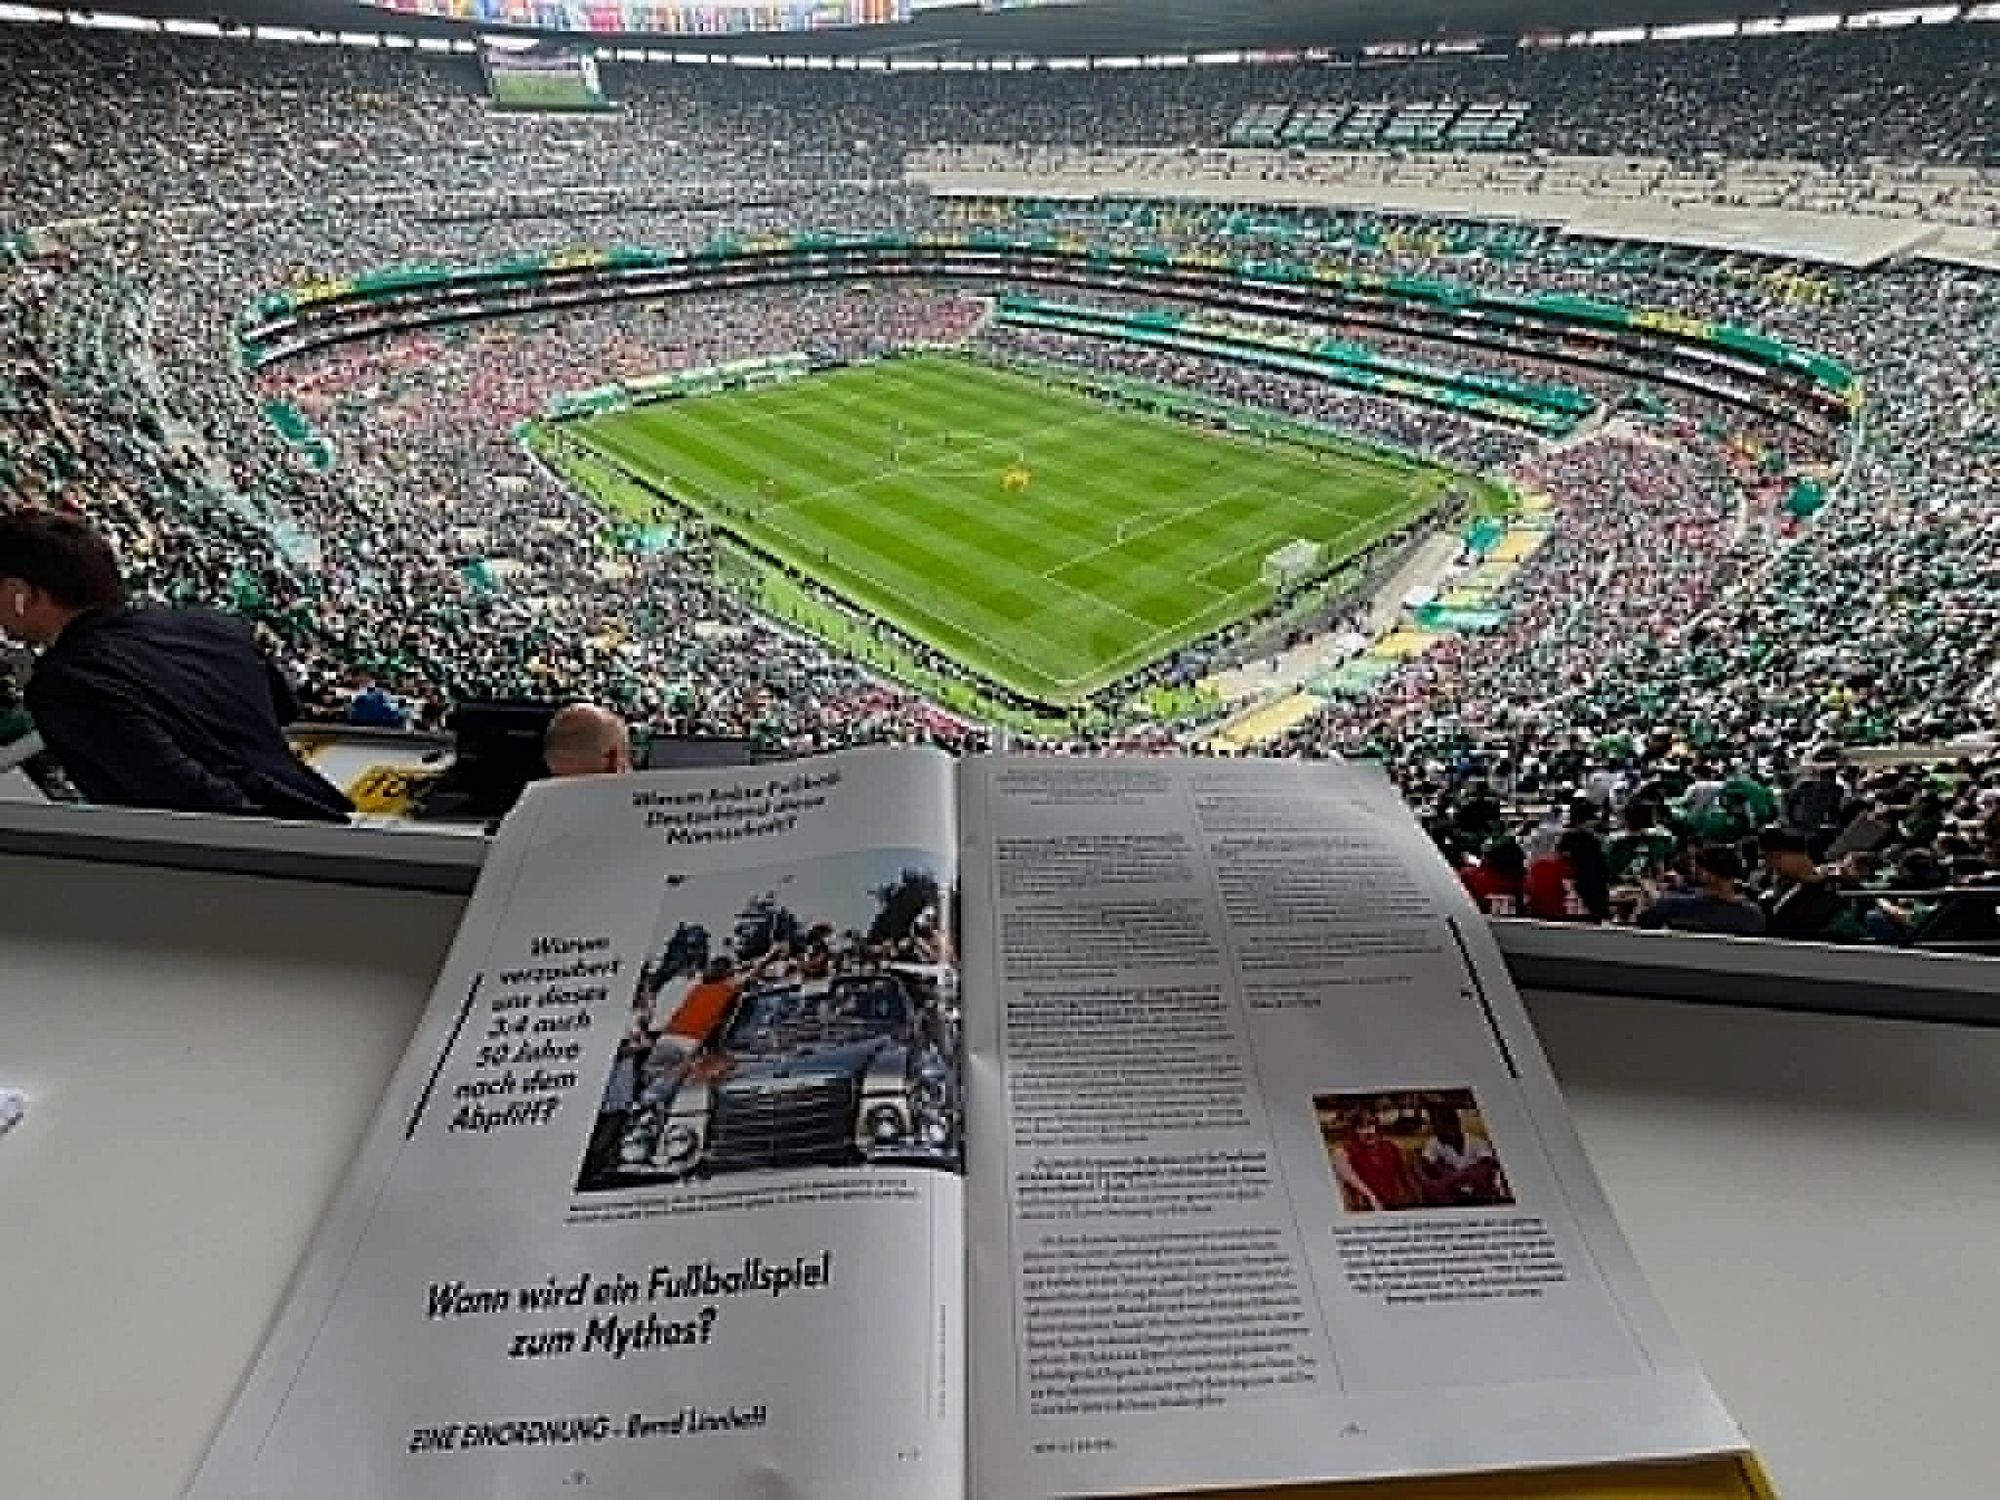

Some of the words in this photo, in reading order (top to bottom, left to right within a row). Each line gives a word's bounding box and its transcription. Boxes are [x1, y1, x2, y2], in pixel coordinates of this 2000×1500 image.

[454, 1070, 516, 1098] nach
[522, 1070, 577, 1093] dem
[428, 1281, 508, 1318] Wann
[518, 1273, 590, 1311] wird
[594, 1274, 639, 1305] ein
[648, 1251, 831, 1302] Fußballspiel
[508, 1330, 576, 1358] zum
[581, 1305, 717, 1359] Mythos?
